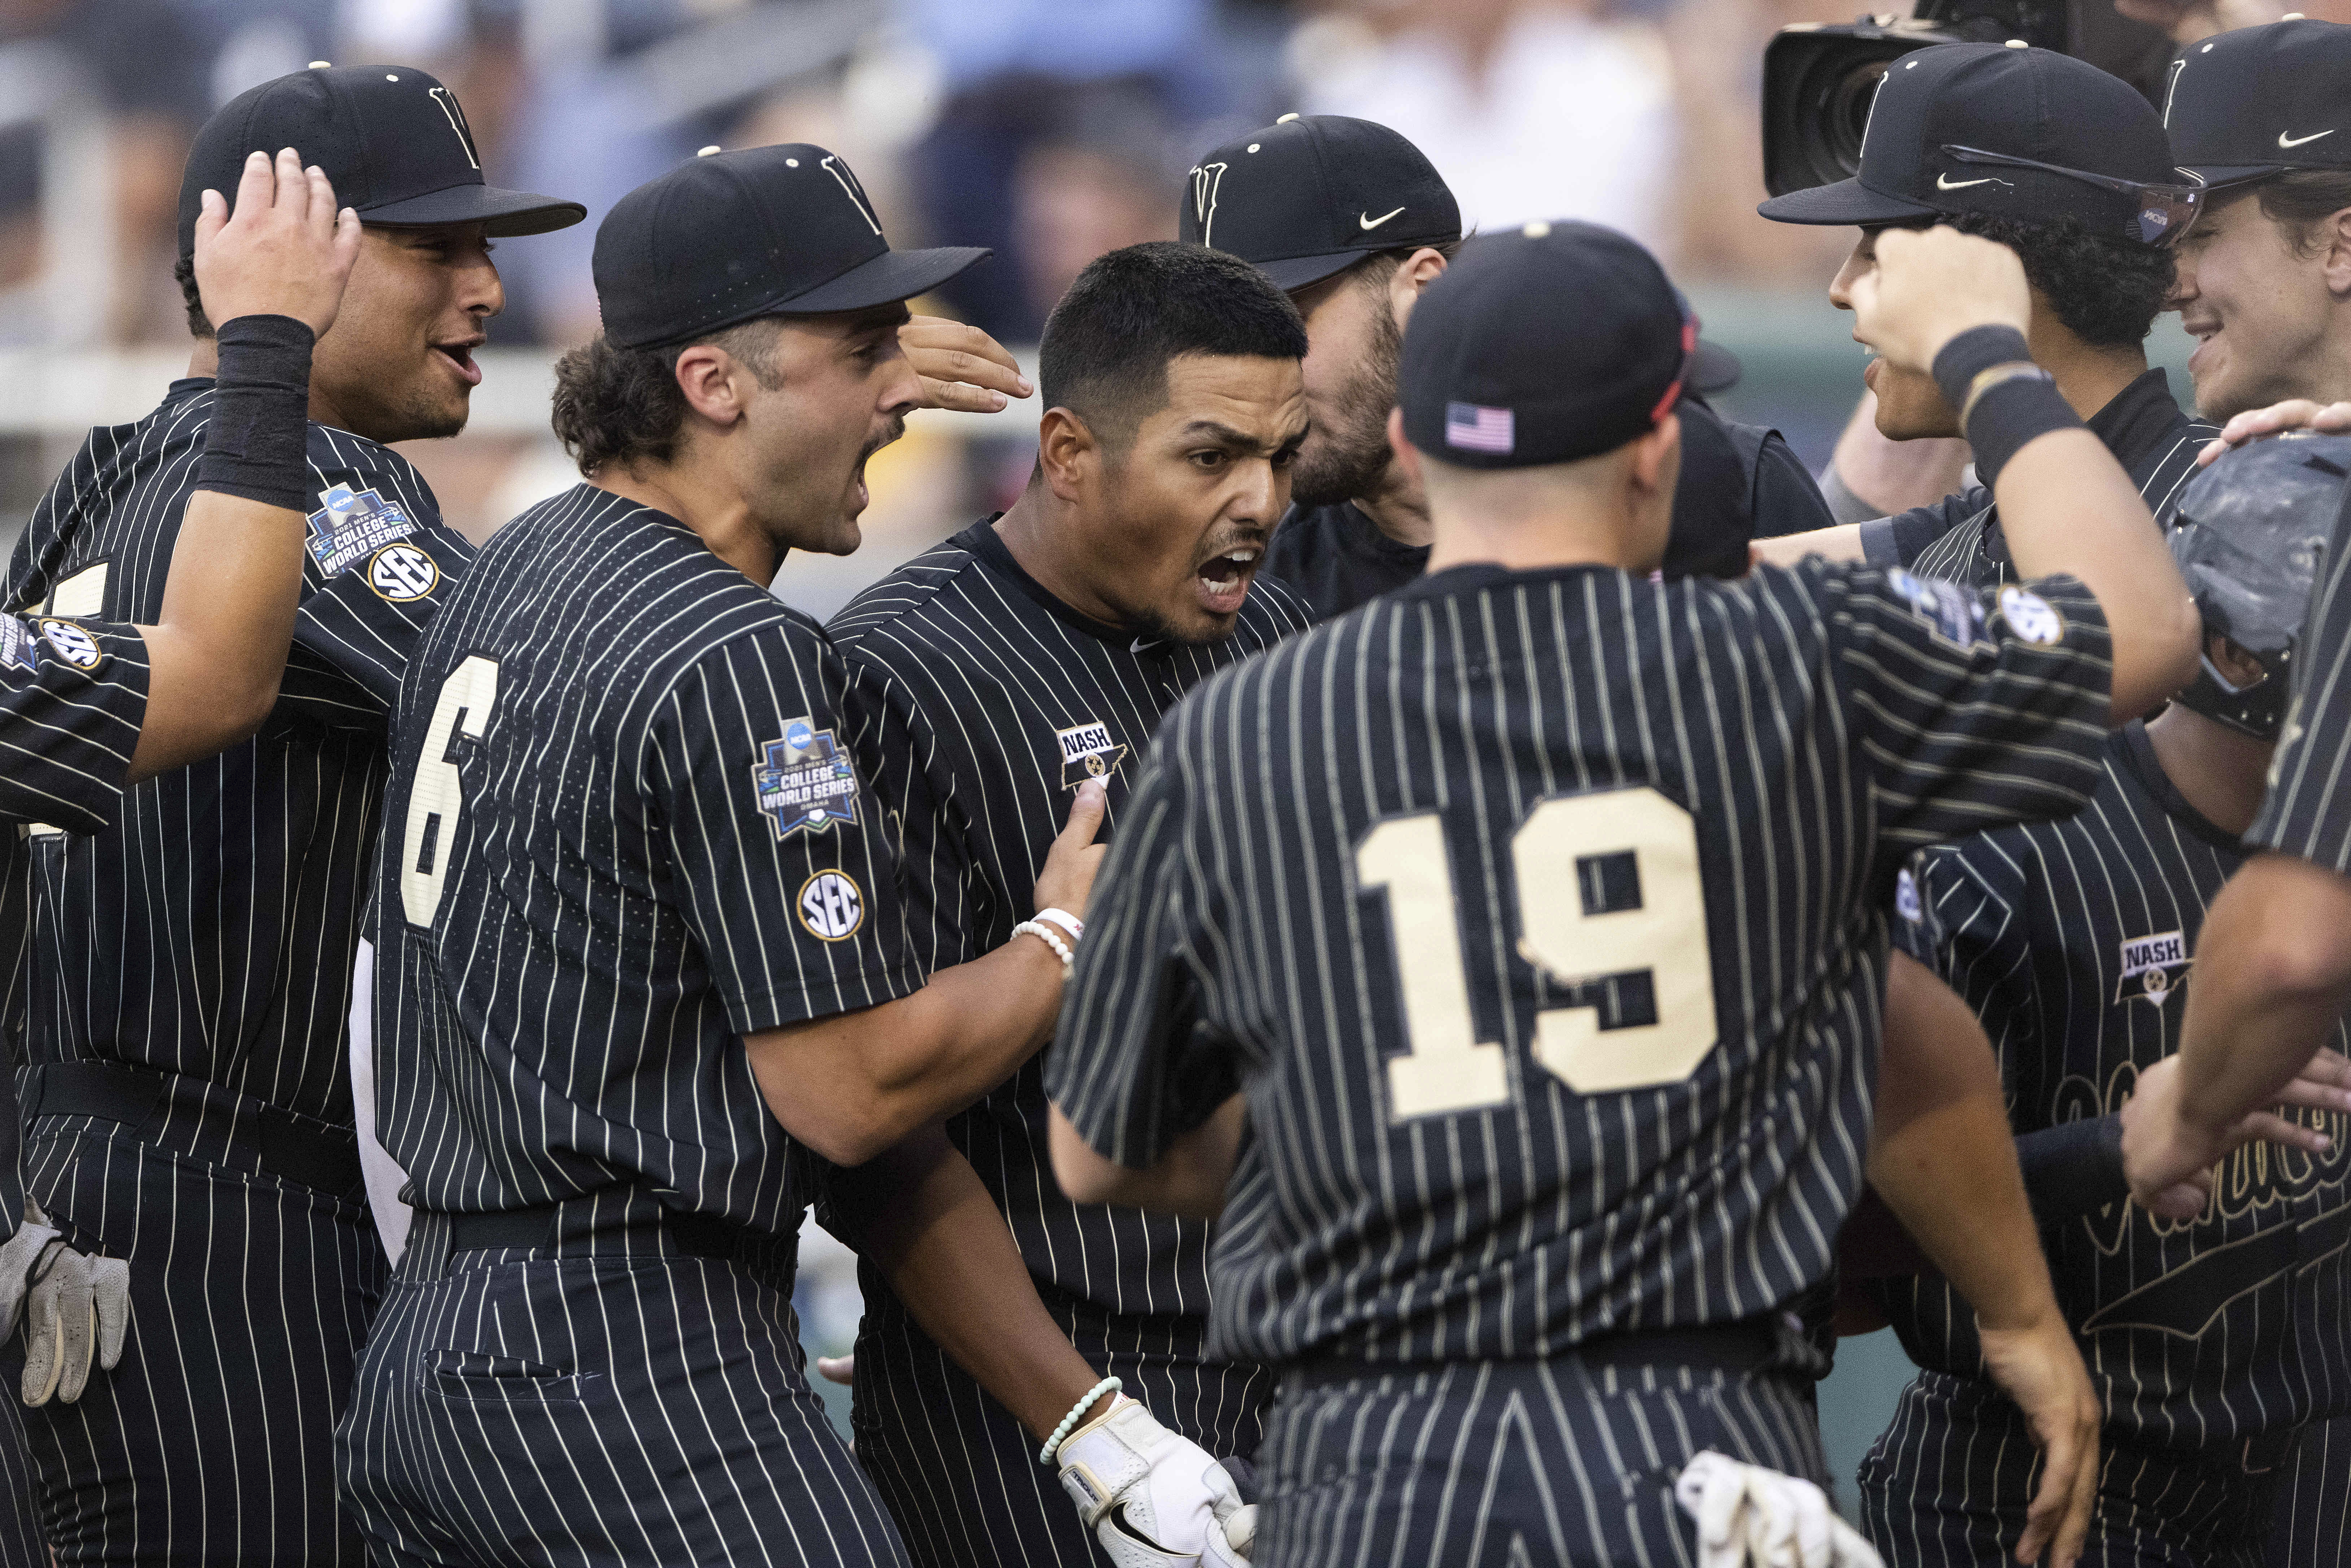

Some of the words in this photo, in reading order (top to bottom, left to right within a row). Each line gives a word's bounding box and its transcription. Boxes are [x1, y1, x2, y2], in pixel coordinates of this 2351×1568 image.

[332, 496, 354, 509] NCAA
[334, 522, 353, 535] 2021
[353, 513, 375, 524] MEN'S
[334, 516, 388, 550] COLLEGE
[323, 541, 368, 574] WORLD
[369, 523, 413, 548] SERIES
[373, 547, 434, 598] SEC
[43, 621, 98, 666] SEC
[1062, 728, 1111, 756] NASH
[400, 654, 500, 929] 6
[762, 786, 811, 809] WORLD
[813, 777, 855, 800] SERIES
[780, 765, 835, 790] COLLEGE
[802, 874, 859, 937] SEC
[1357, 786, 1719, 1121] 19
[2126, 938, 2181, 969] NASH
